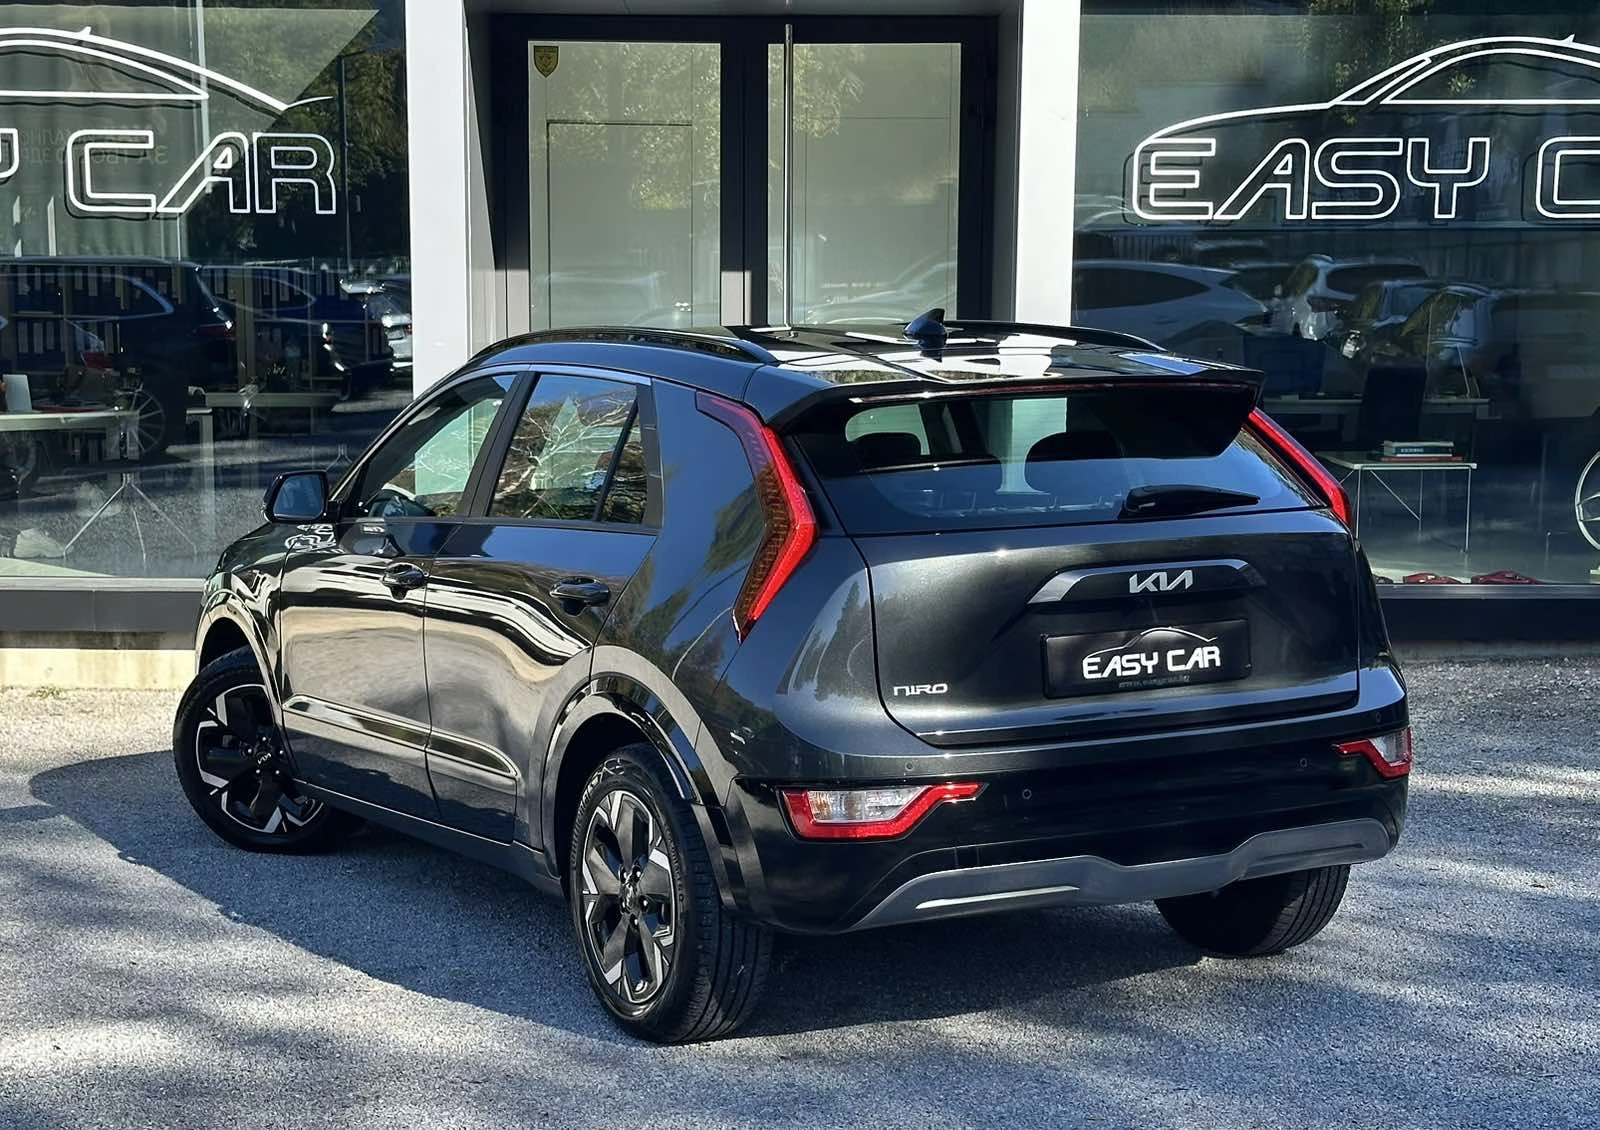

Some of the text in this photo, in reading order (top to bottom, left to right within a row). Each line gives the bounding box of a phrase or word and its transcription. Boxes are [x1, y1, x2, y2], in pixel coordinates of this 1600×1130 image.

[66, 129, 337, 215] CAR
[1132, 137, 1490, 220] EASY
[1128, 569, 1194, 593] KIA
[1082, 645, 1221, 680] EASY CAR
